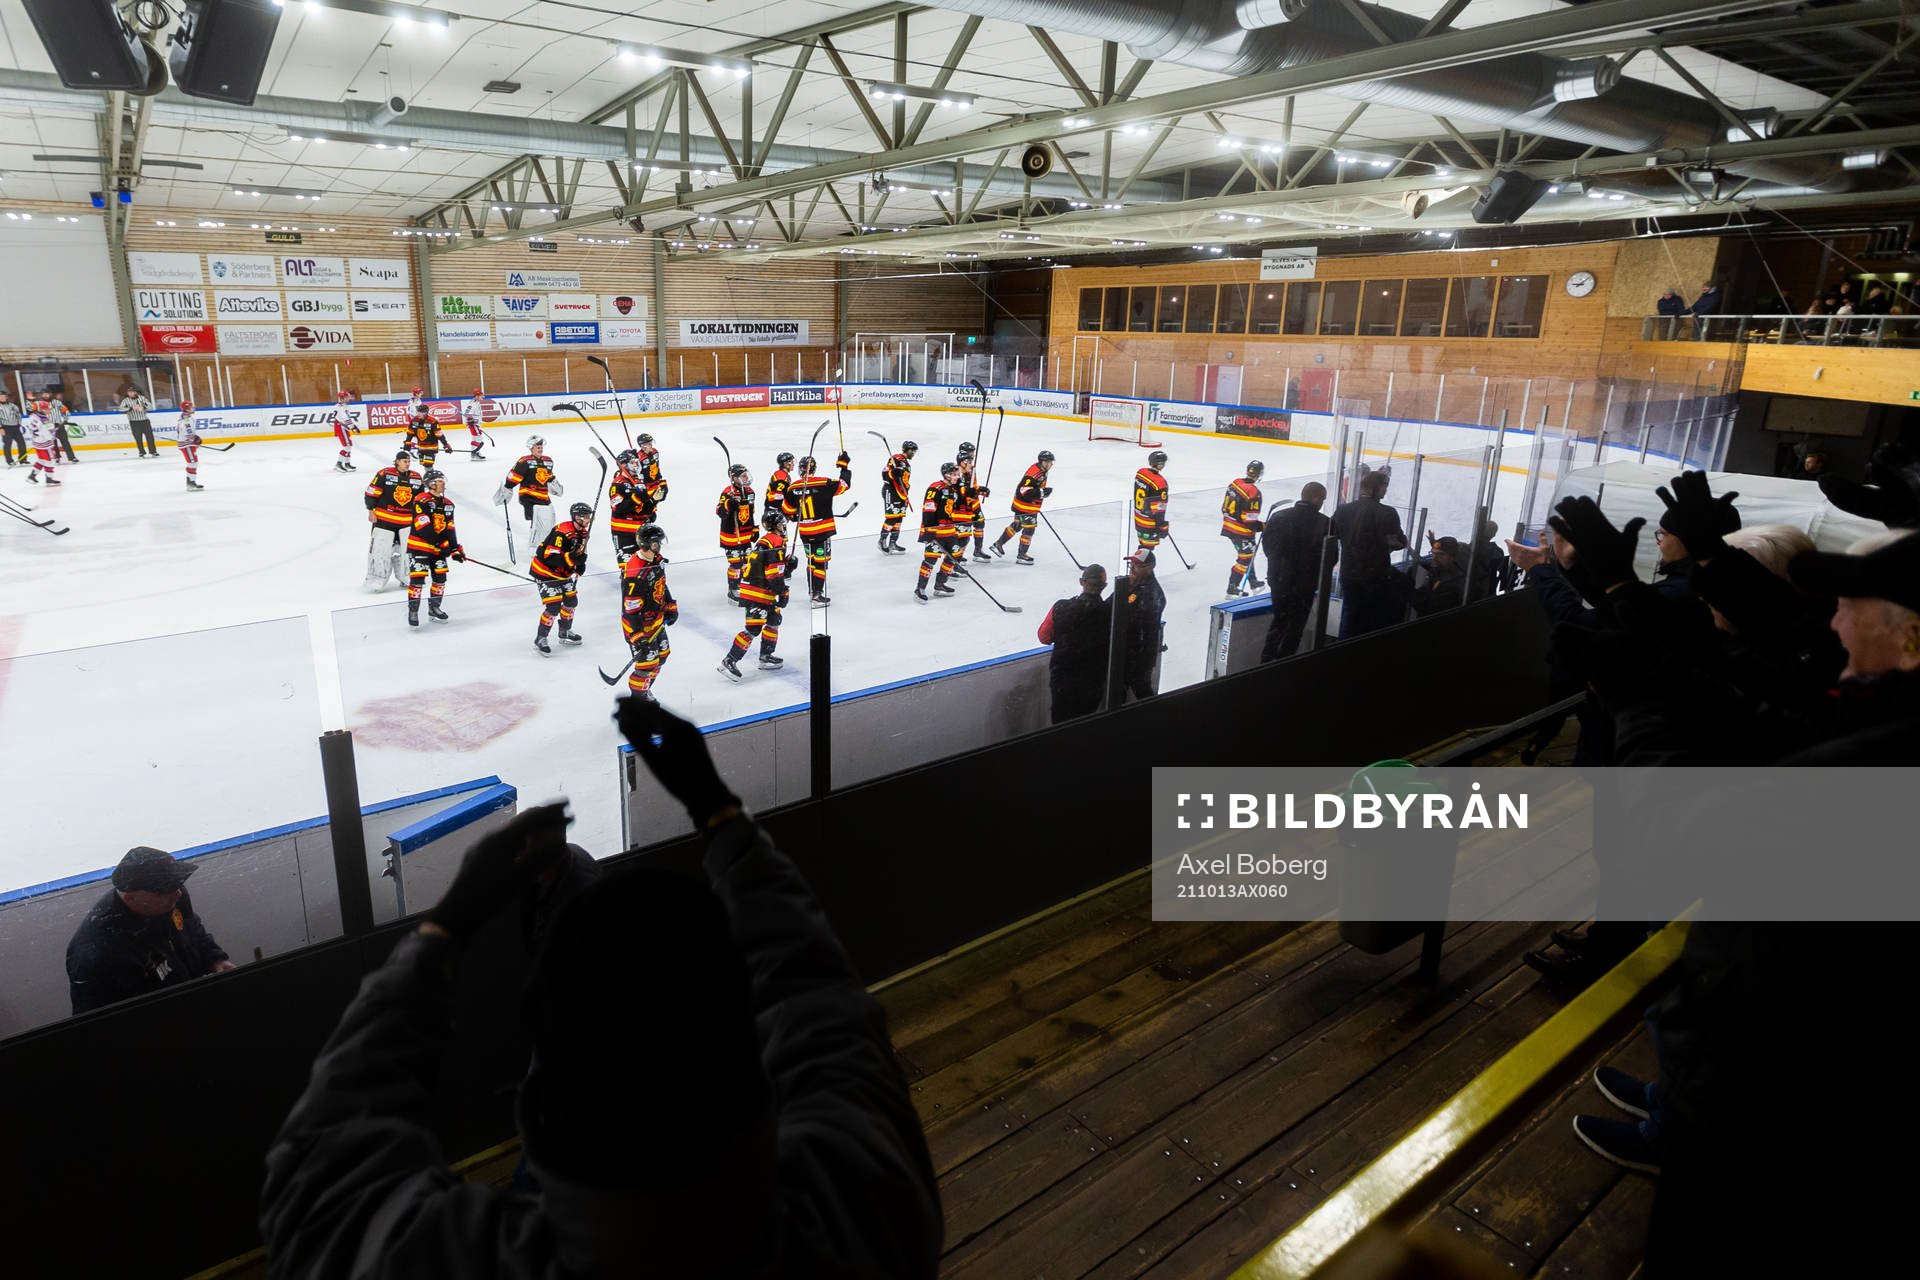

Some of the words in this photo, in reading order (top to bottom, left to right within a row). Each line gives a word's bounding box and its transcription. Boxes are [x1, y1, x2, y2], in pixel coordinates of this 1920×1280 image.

[231, 262, 272, 271] Söderberg
[285, 259, 316, 277] ALT
[239, 271, 272, 279] Partners
[359, 266, 399, 281] Scapa
[139, 291, 203, 309] CUTTING
[219, 297, 280, 313] Atteviks
[511, 299, 531, 311] AVS
[292, 300, 320, 313] GBJ
[442, 305, 482, 314] MASKIN
[163, 309, 203, 319] SOLUTIONS
[690, 323, 799, 334] LOKALTIDNINGEN
[313, 330, 352, 343] VIDA
[715, 334, 744, 343] ALVESTA
[654, 392, 693, 403] Söderberg
[705, 393, 764, 404] SVETRUCK
[773, 392, 795, 402] Hall
[796, 391, 822, 401] Miba
[860, 391, 910, 399] prefabsystem
[911, 392, 924, 400] syd
[371, 405, 409, 417] ALVEST
[499, 401, 536, 416] VIDA
[654, 402, 661, 411] &
[661, 401, 693, 411] Partners
[372, 415, 409, 427] BILDEL
[1135, 488, 1146, 510] 6
[1161, 491, 1167, 500] 6
[1222, 495, 1237, 515] 14
[1250, 500, 1260, 510] 14
[628, 582, 635, 595] 7
